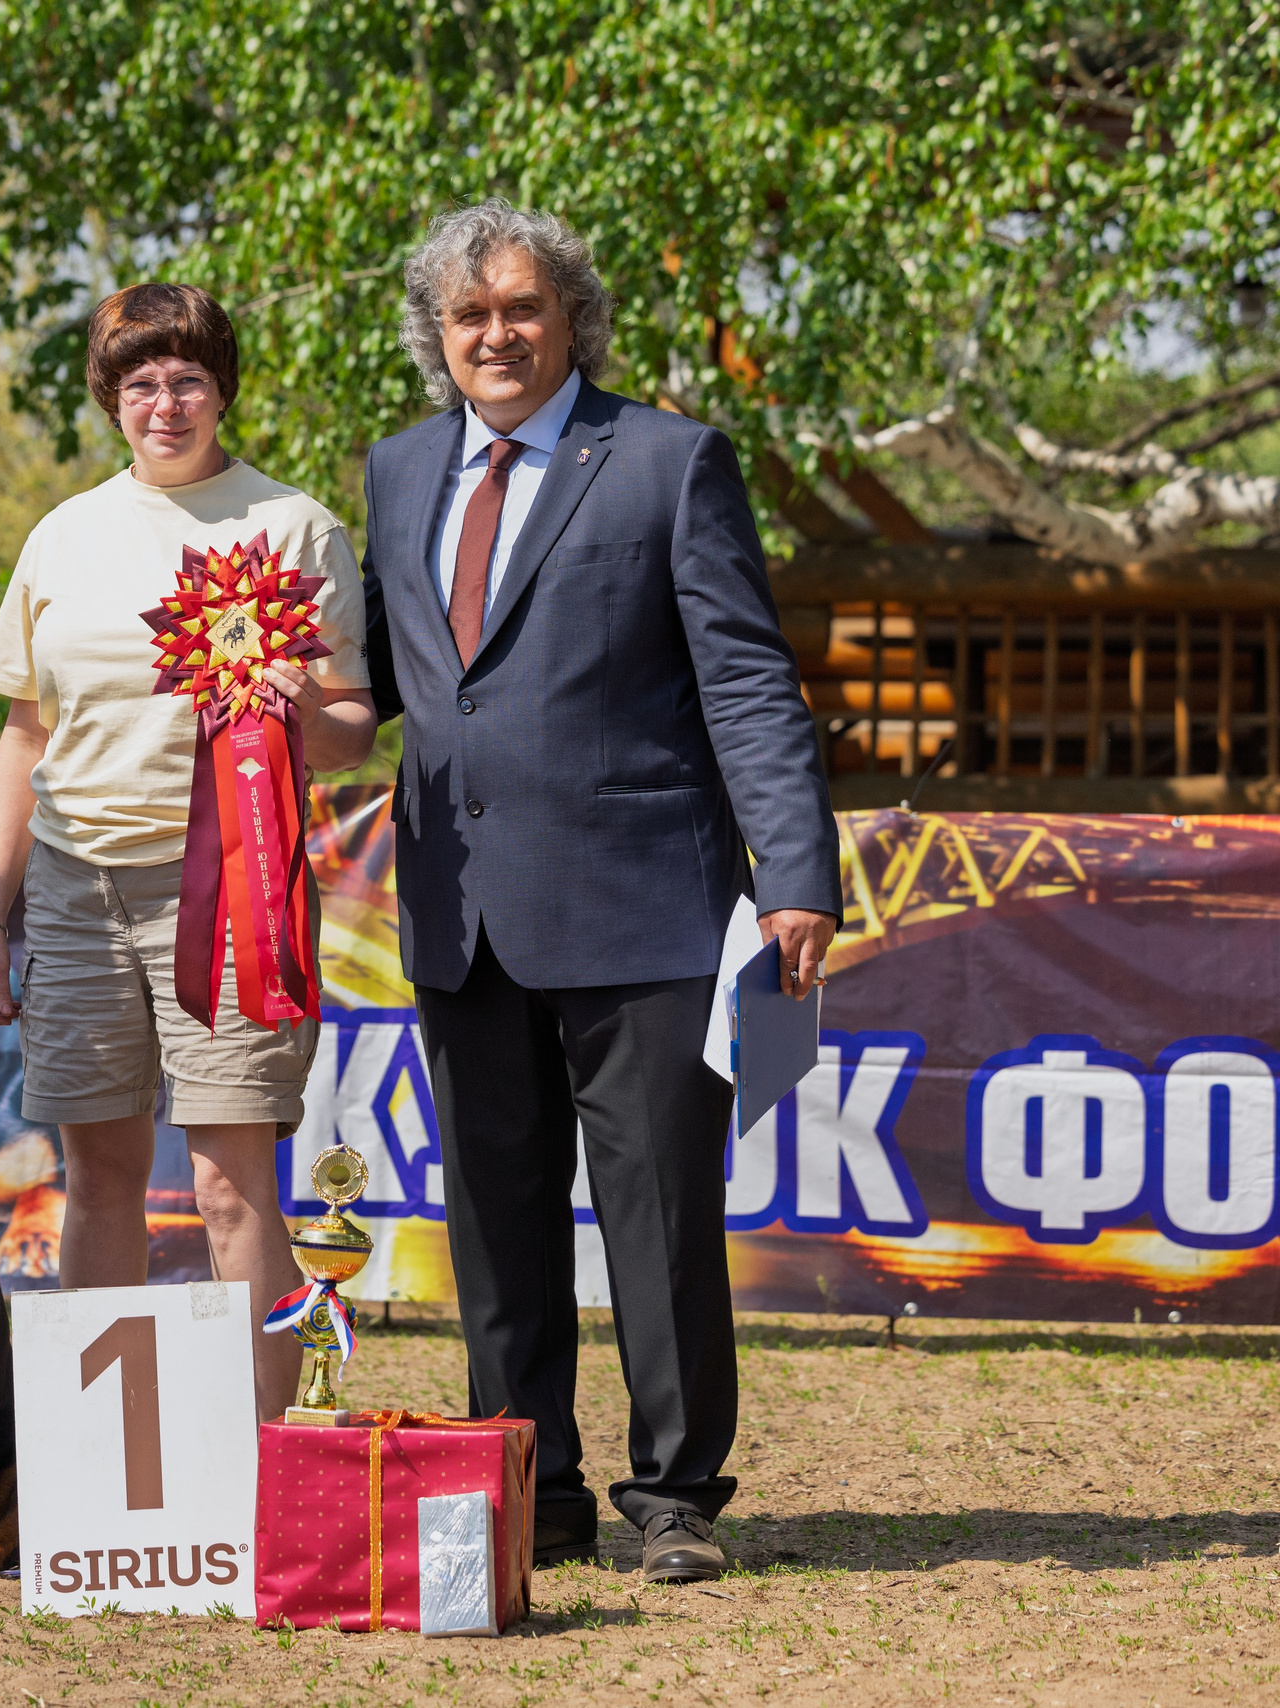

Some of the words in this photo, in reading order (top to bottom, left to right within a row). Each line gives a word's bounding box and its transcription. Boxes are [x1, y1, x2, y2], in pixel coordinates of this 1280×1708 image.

[250, 787, 265, 845] ЛУЧШИЙ
[257, 852, 272, 900] ЮНИОР
[79, 1315, 164, 1511] 1
[34, 1552, 43, 1595] PREMIUM
